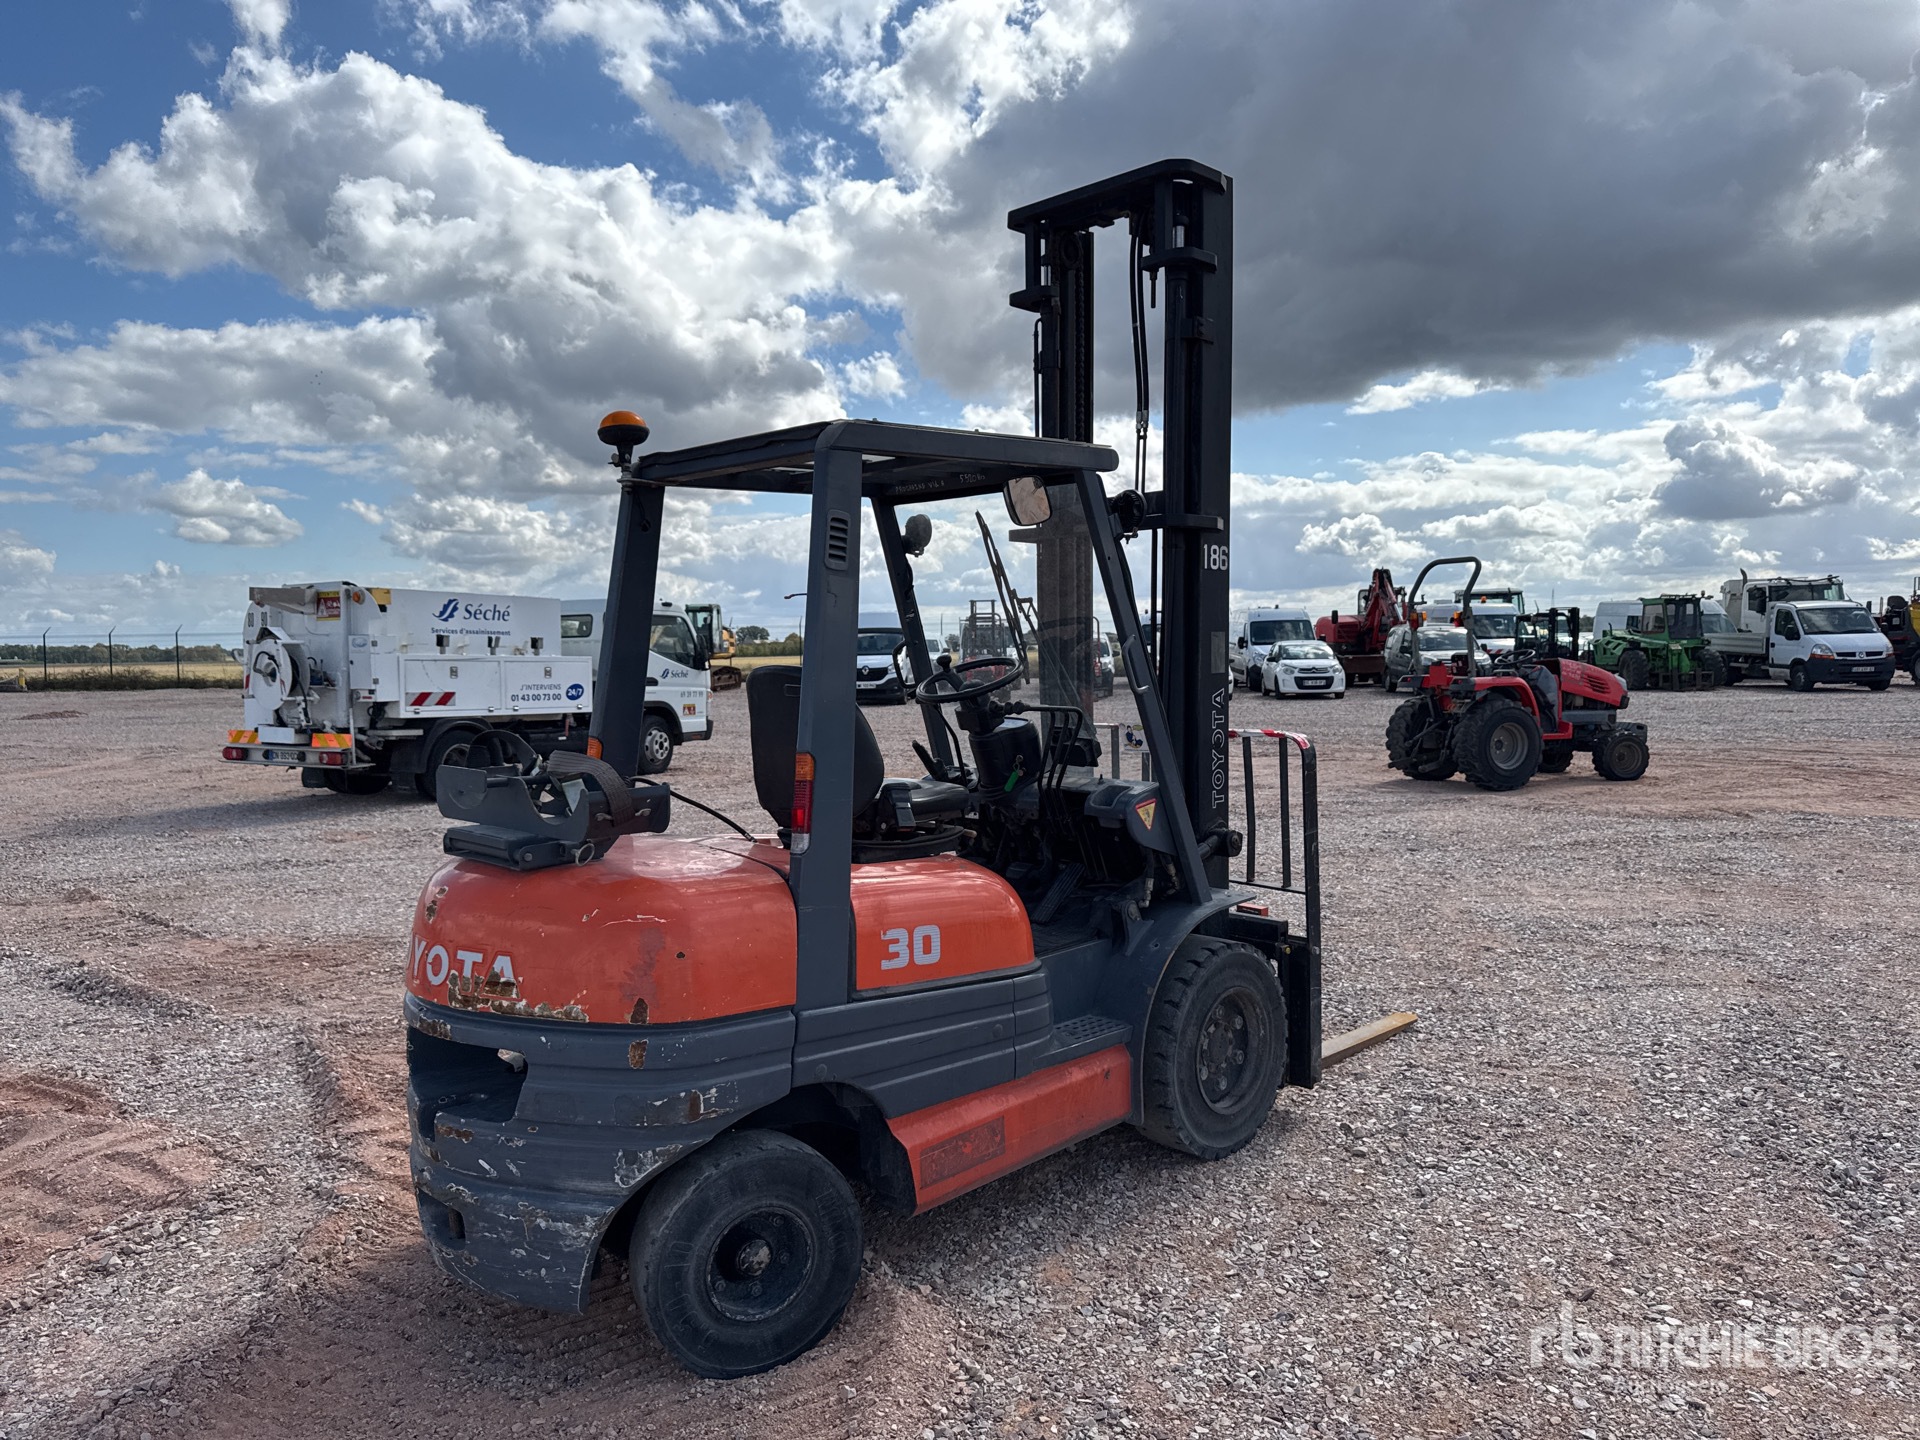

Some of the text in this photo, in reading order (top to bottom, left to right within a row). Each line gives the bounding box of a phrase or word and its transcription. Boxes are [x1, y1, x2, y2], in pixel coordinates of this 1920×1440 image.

[1203, 543, 1228, 571] 186
[463, 603, 511, 622] Séché
[431, 627, 511, 636] Services d'assainissement
[671, 670, 688, 678] Séché
[511, 694, 519, 702] 01
[532, 693, 541, 701] 00
[542, 693, 551, 701] 73
[567, 688, 583, 697] 24/7
[1212, 688, 1225, 809] TOYOTA
[881, 924, 941, 971] 30
[409, 935, 520, 999] YOTA
